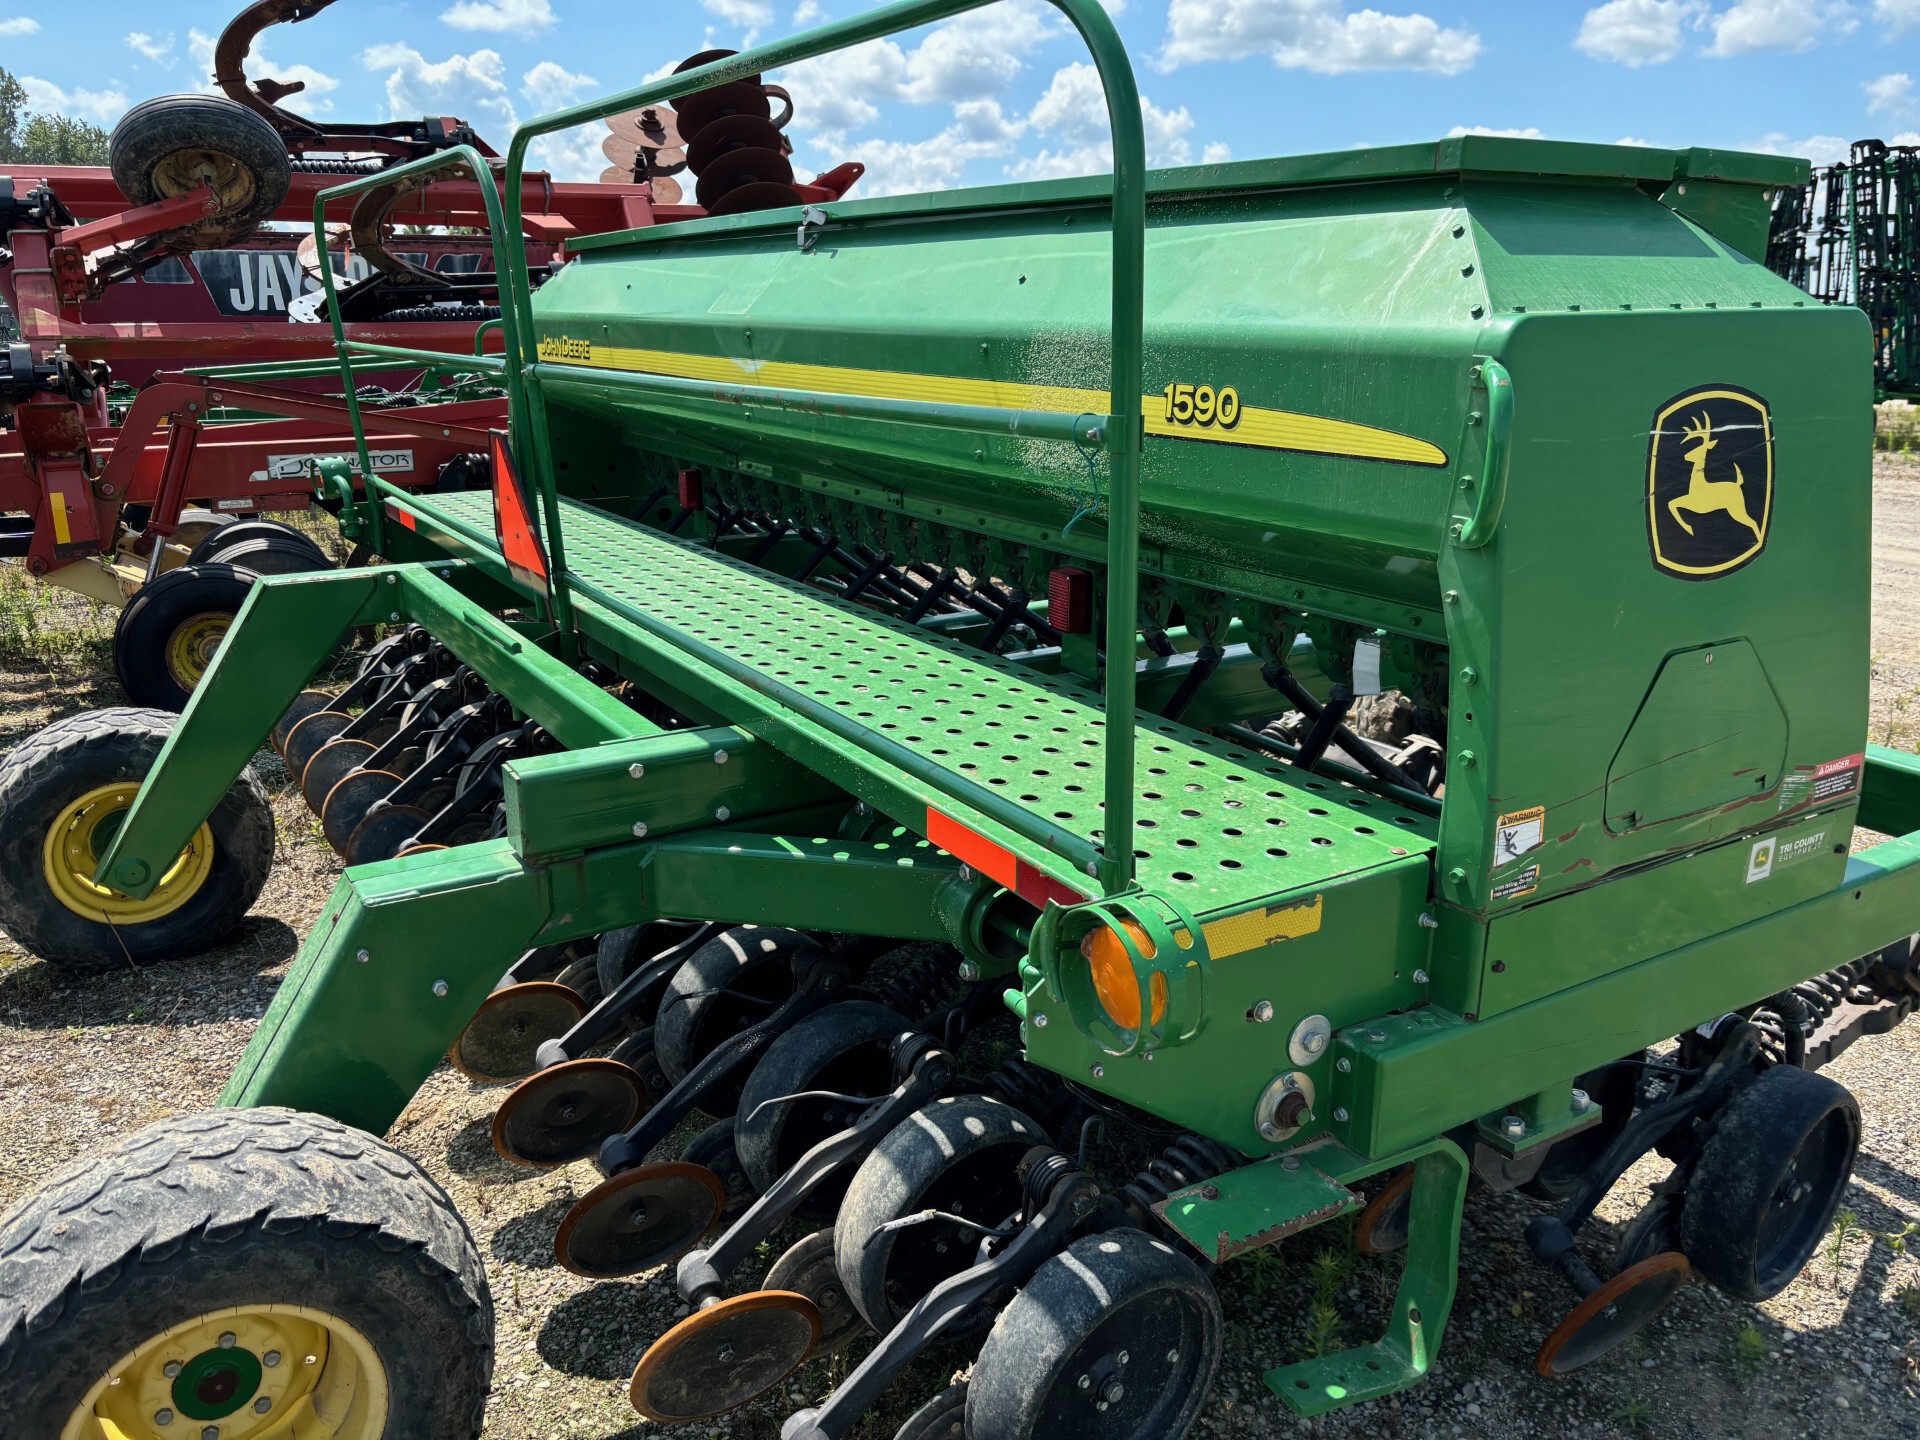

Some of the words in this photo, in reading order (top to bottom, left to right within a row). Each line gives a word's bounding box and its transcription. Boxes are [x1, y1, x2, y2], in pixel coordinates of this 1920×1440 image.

[562, 335, 590, 360] DEERE
[1164, 382, 1241, 432] 1590
[1824, 759, 1850, 774] DANGER
[1507, 809, 1541, 825] WARNING
[1779, 841, 1822, 862] EQUIPMENT
[1780, 842, 1793, 854] TRI
[1793, 832, 1825, 850] COUNTY
